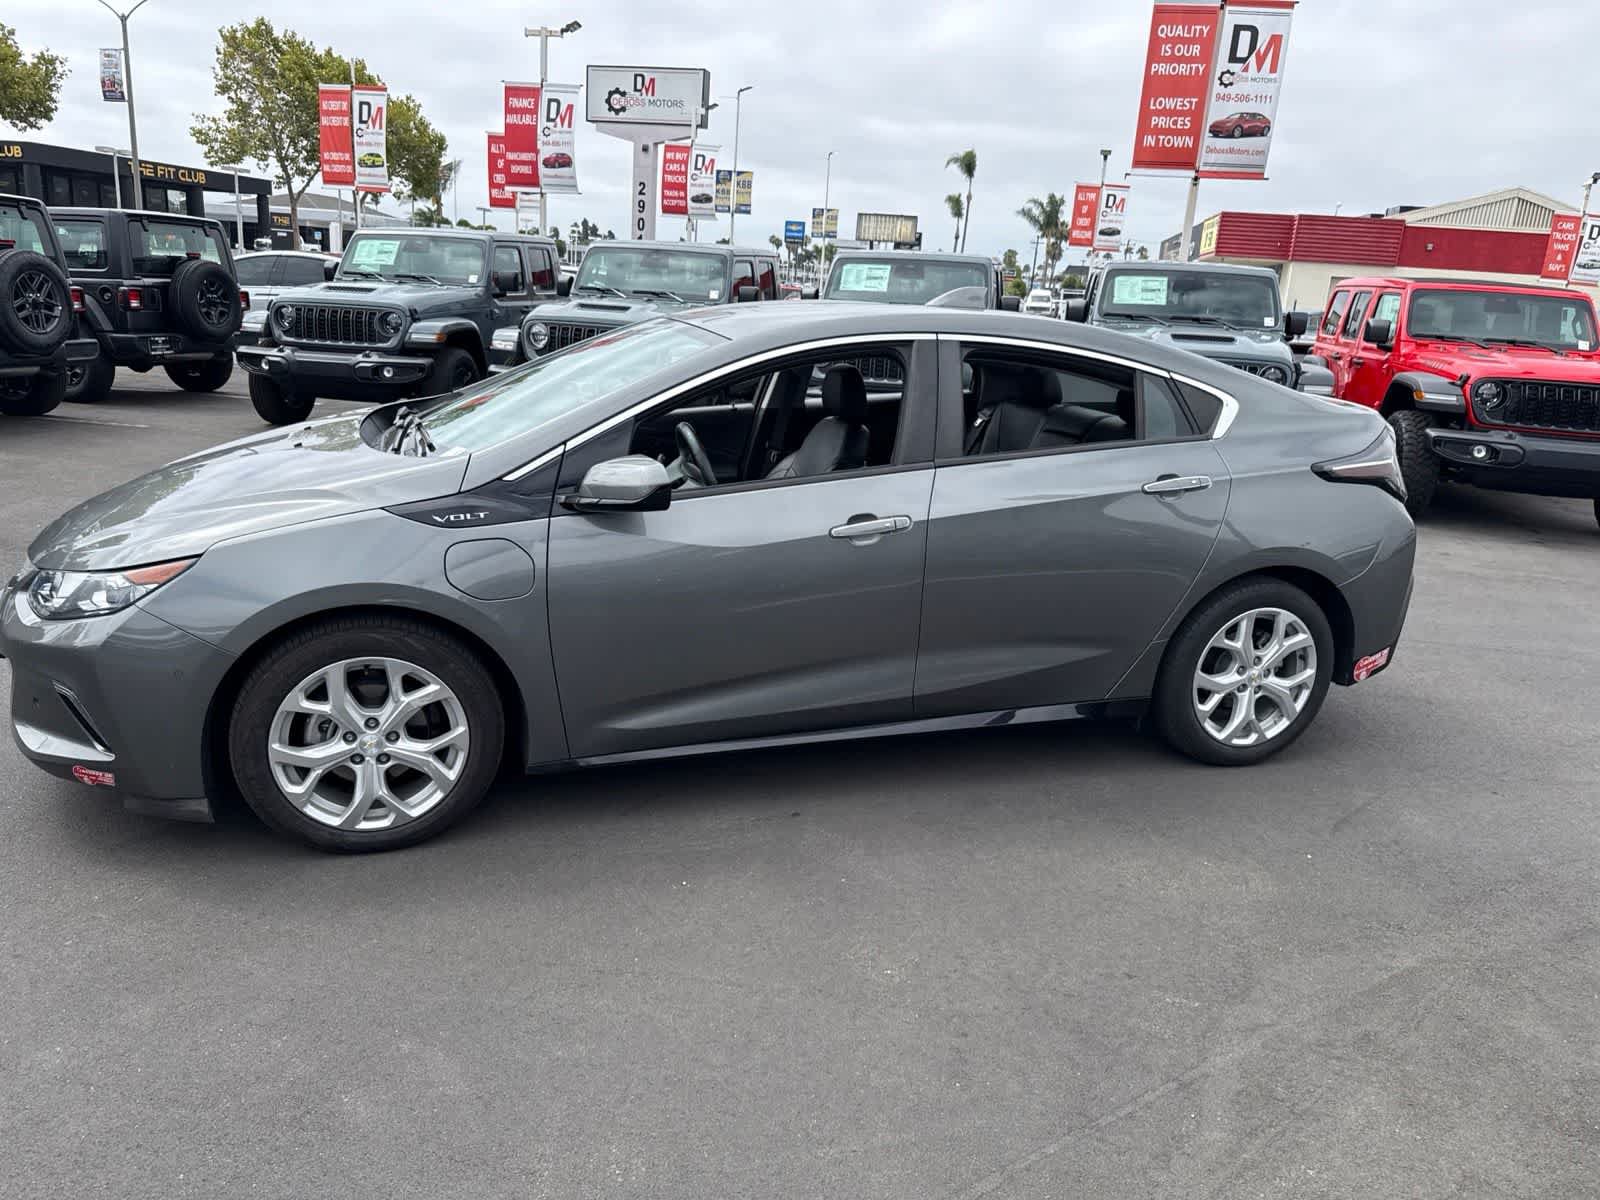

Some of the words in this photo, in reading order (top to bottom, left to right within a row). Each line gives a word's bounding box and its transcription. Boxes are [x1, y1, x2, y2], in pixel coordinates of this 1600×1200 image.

[1157, 25, 1210, 38] QUALITY
[1161, 44, 1171, 56] IS
[1174, 44, 1200, 57] OUR
[1228, 24, 1283, 74] DM
[1151, 63, 1206, 76] PRIORITY
[633, 73, 656, 96] DM
[509, 97, 535, 108] FINANCE
[612, 97, 646, 107] DEBOSS
[648, 99, 684, 108] MOTORS
[1149, 98, 1198, 111] LOWEST
[1215, 93, 1273, 104] 949-506-1111
[358, 101, 384, 130] DM
[506, 114, 536, 125] AVAILABLE
[546, 98, 574, 128] DM
[1151, 117, 1191, 129] PRICES
[1144, 135, 1156, 147] IN
[1158, 136, 1193, 148] TOWN
[676, 152, 688, 160] BUY
[694, 154, 715, 175] DM
[157, 166, 176, 180] FIT
[178, 169, 206, 185] CLUB
[664, 175, 686, 184] TRUCKS
[737, 181, 752, 189] KBB
[1105, 194, 1126, 213] DM
[637, 182, 646, 240] 290
[1552, 232, 1576, 241] TRUCKS
[1588, 224, 1600, 241] D
[1553, 243, 1570, 251] VANS
[432, 511, 489, 523] VOLT
